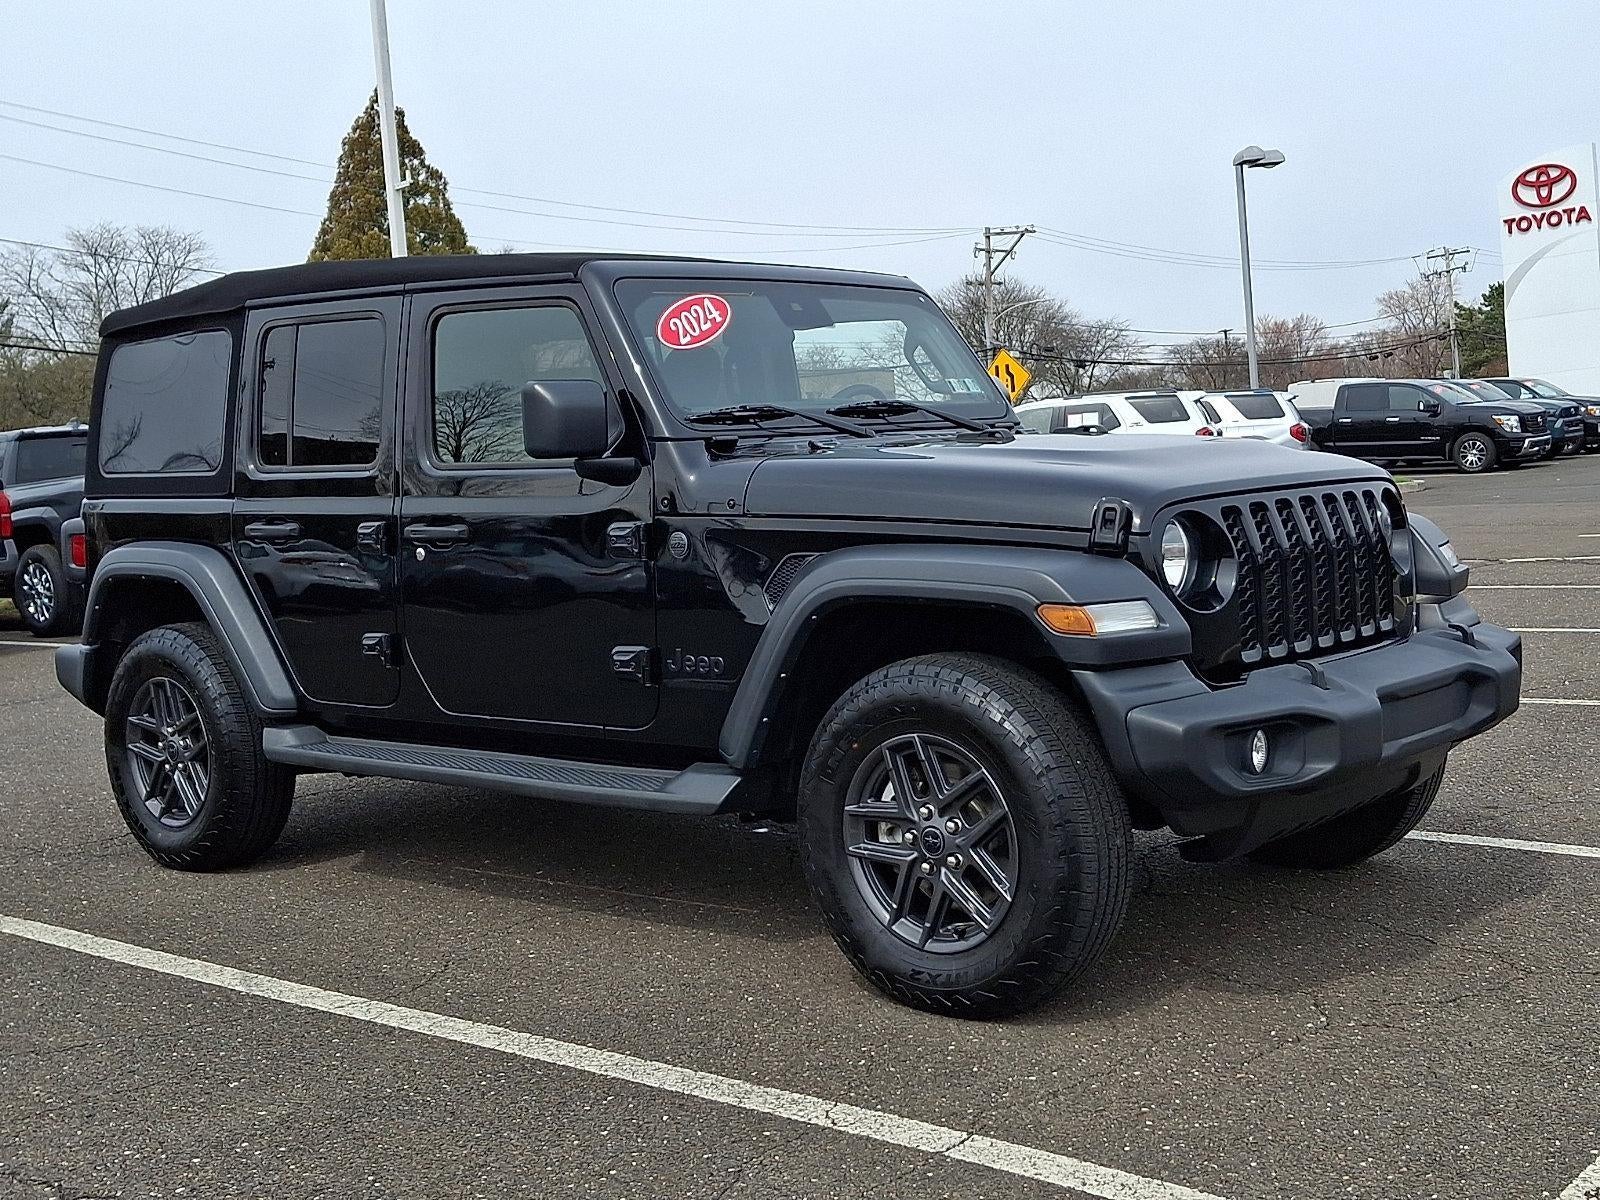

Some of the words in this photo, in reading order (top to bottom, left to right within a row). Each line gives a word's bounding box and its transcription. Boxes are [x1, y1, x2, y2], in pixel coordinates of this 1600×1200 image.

[1503, 206, 1592, 234] TOYOTA
[669, 297, 722, 345] 2024
[666, 648, 725, 676] Jeep
